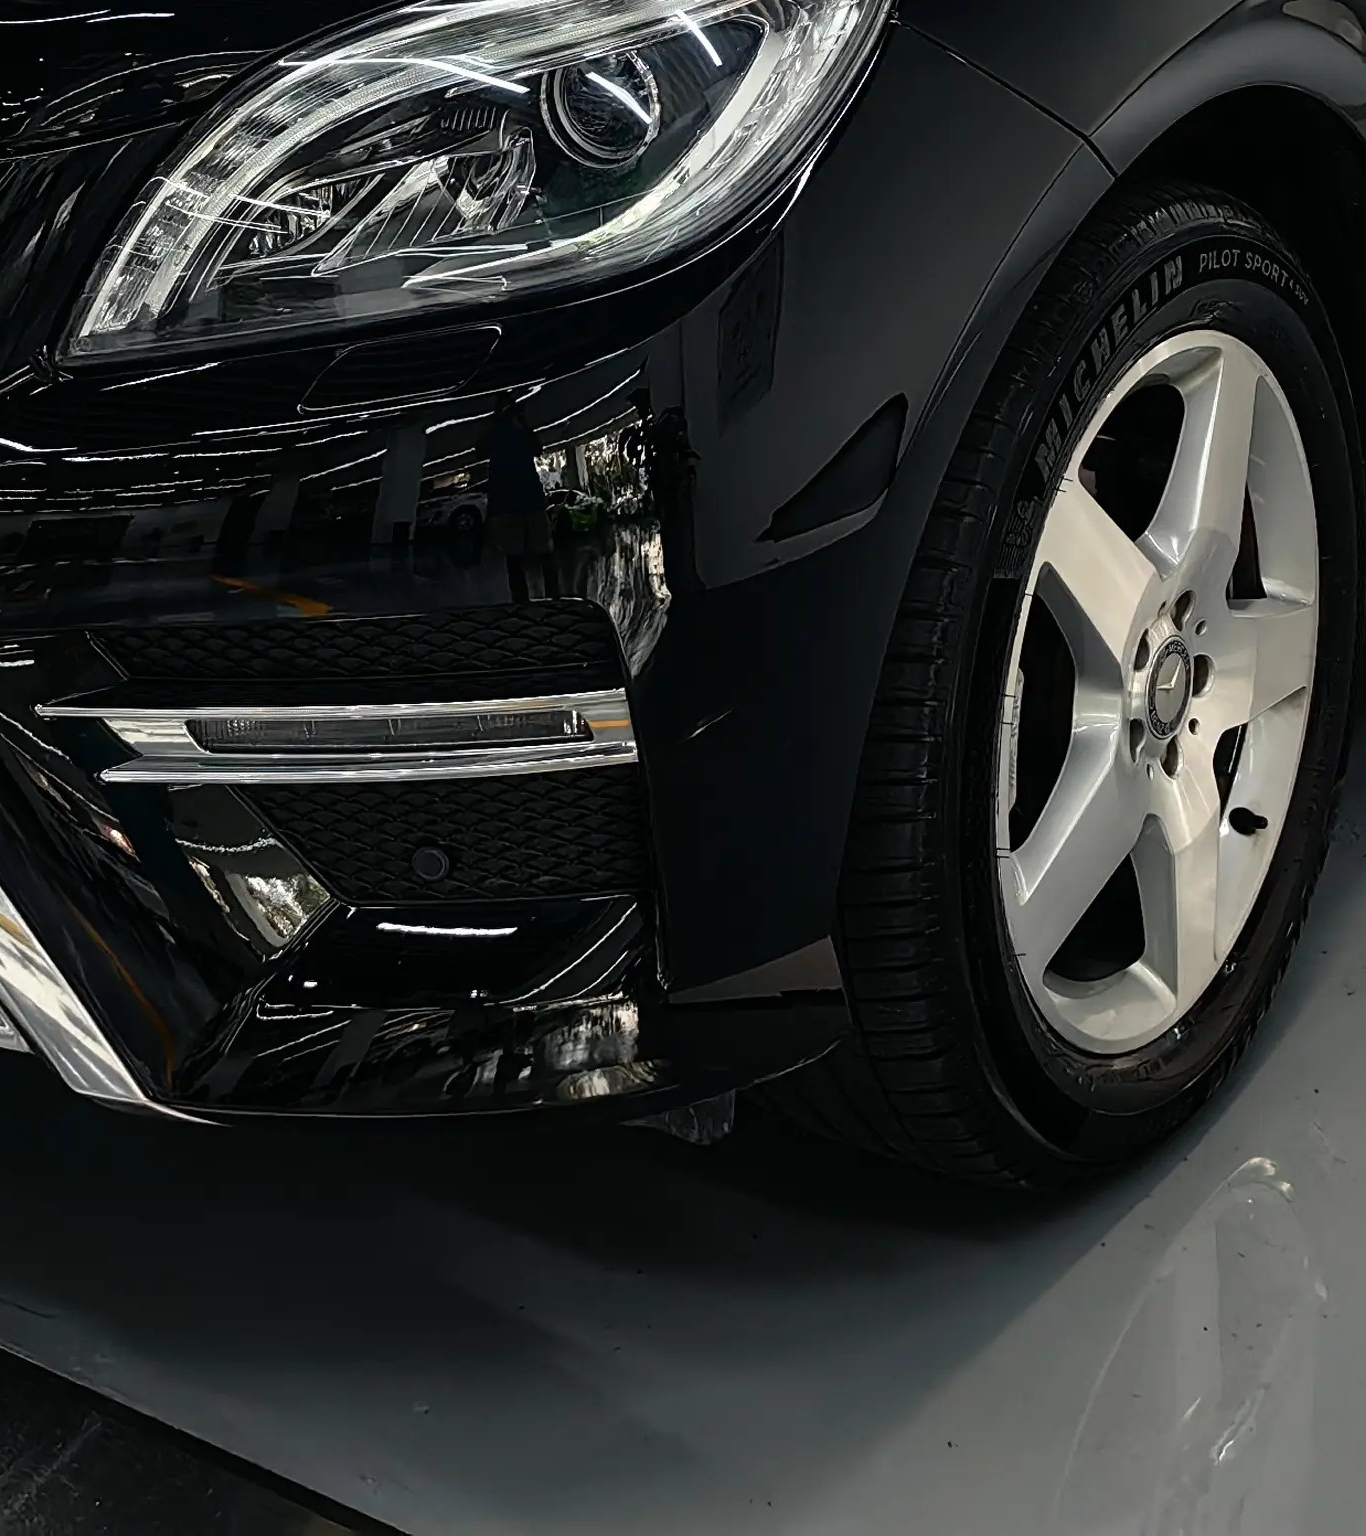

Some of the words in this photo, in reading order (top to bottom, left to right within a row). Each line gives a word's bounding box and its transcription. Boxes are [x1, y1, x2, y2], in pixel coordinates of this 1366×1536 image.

[1035, 255, 1183, 484] MICHELIN
[1199, 249, 1241, 274] PILOT
[1244, 251, 1289, 287] SPORT
